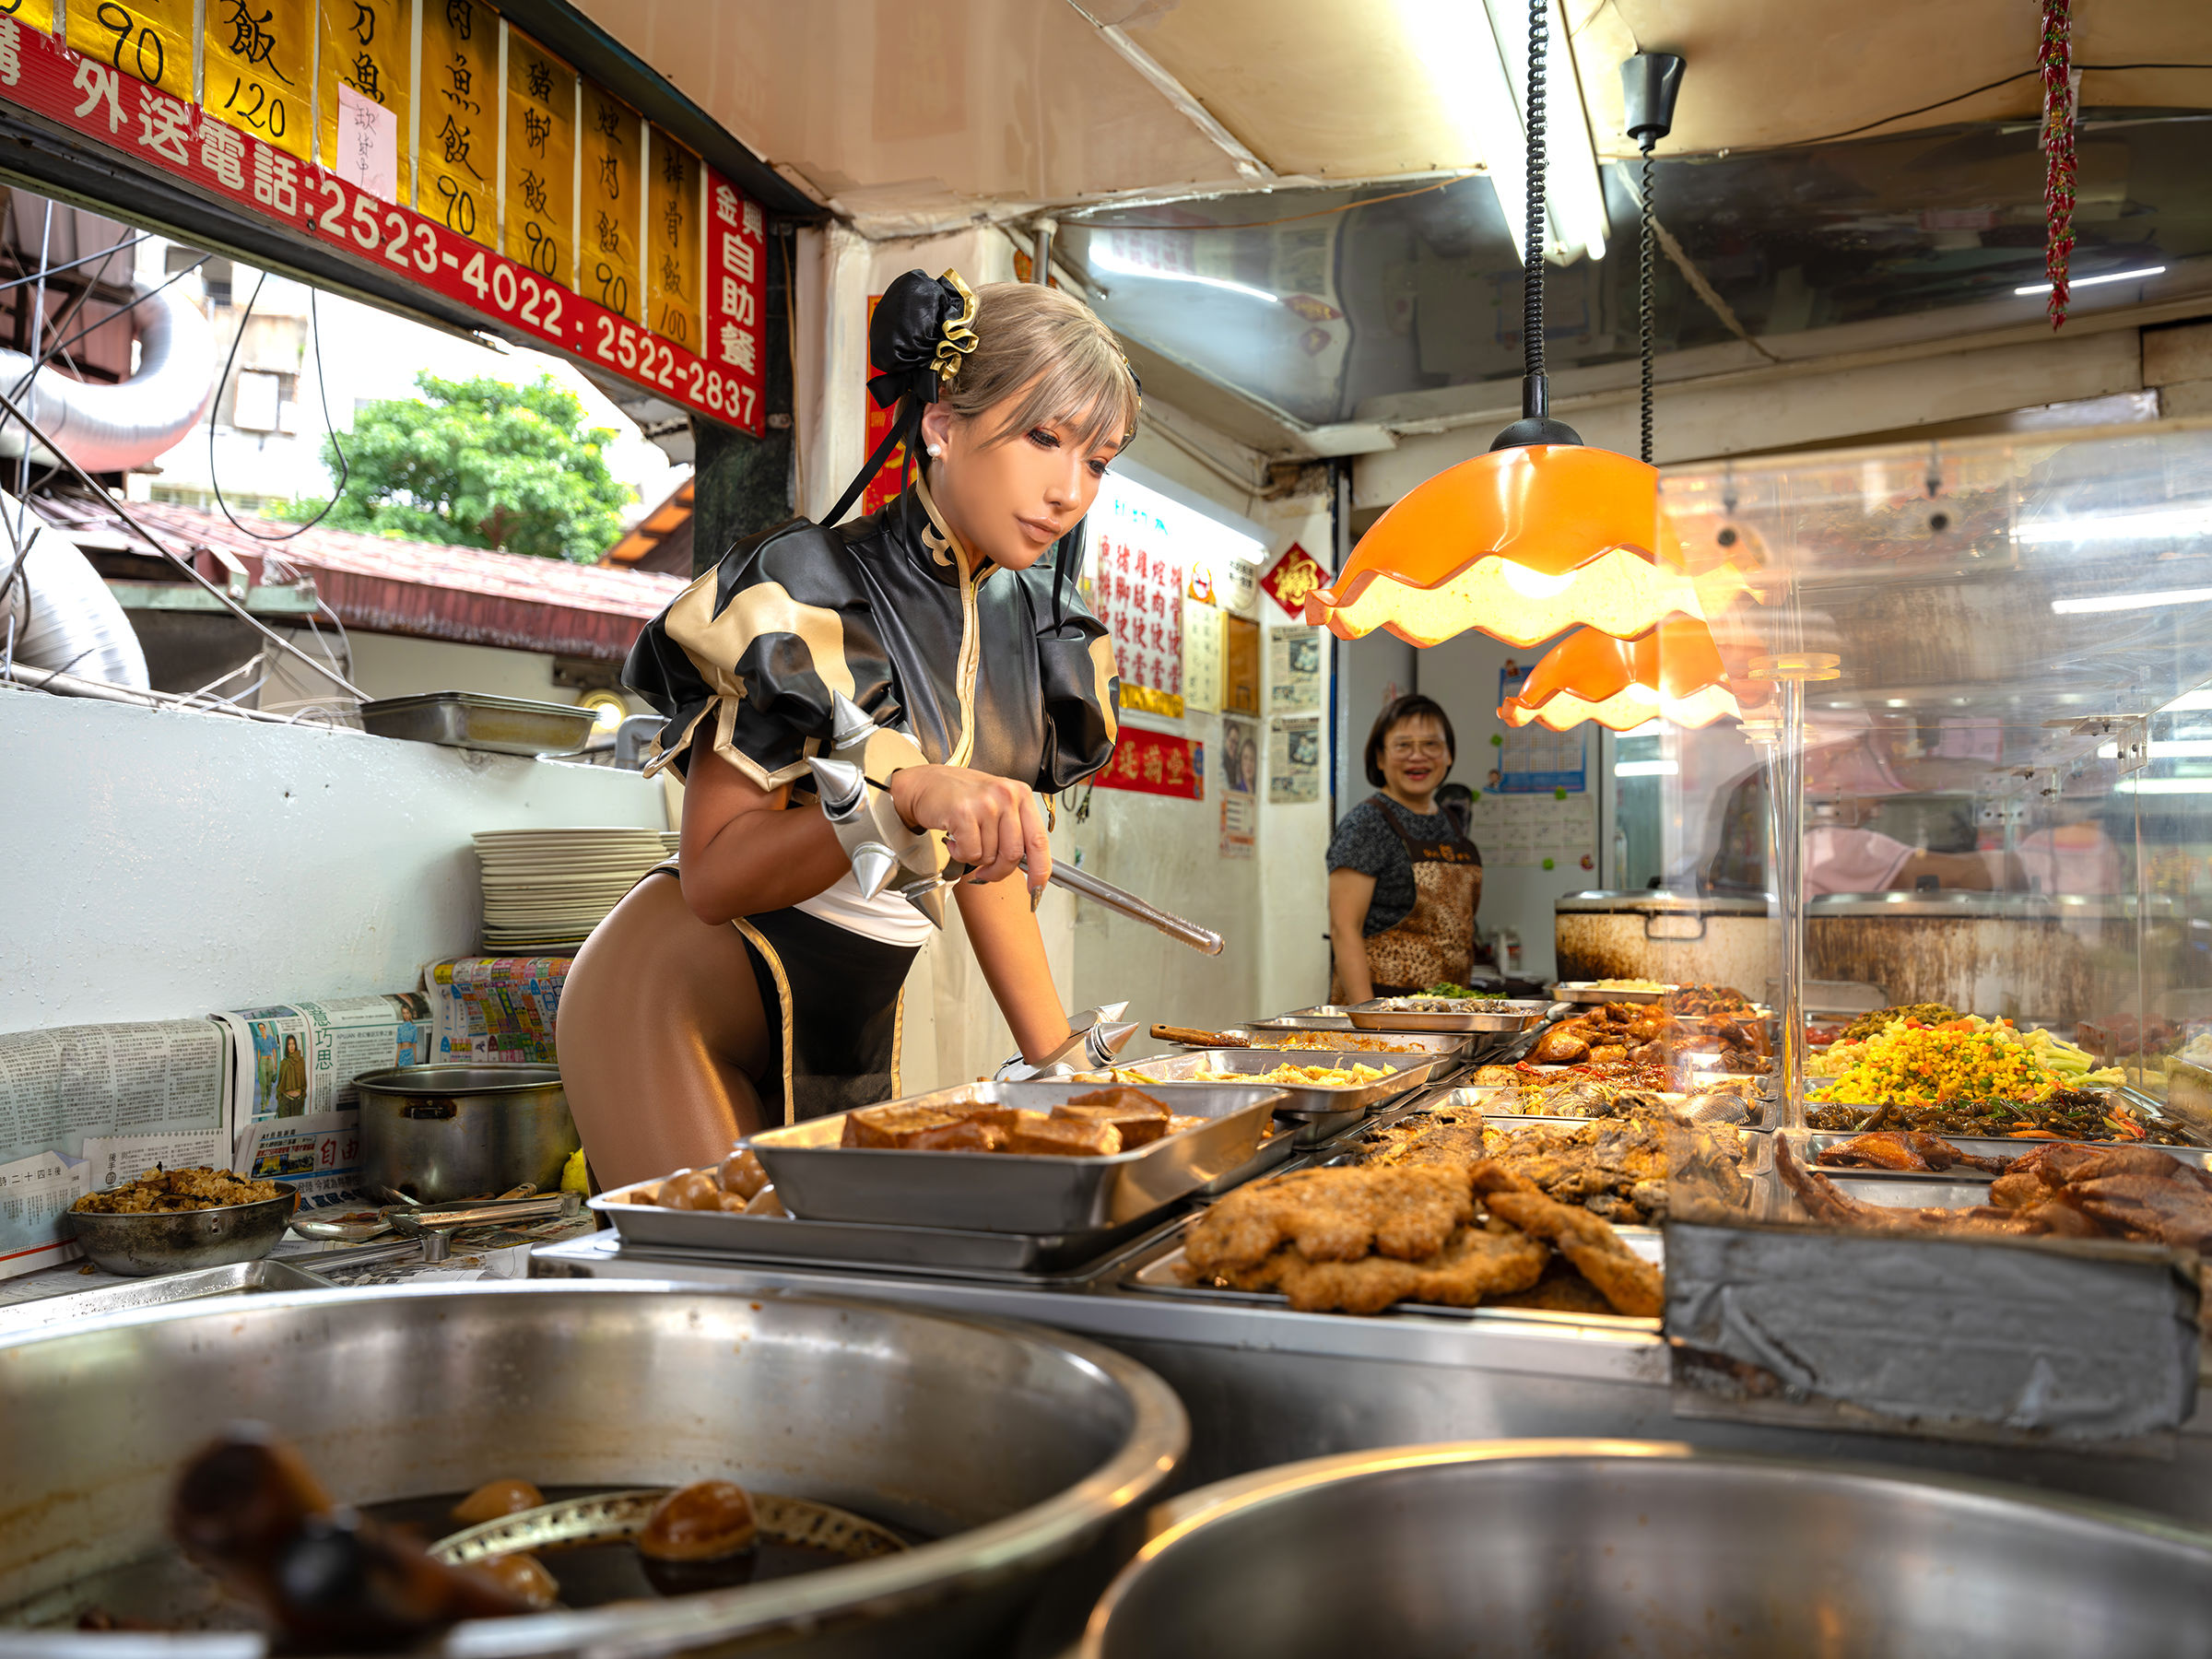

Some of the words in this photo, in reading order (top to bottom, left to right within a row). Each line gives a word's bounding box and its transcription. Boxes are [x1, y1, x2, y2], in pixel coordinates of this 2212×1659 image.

[97, 4, 163, 85] 90
[219, 0, 295, 86] 飯
[344, 1, 385, 103] 刀魚
[224, 76, 286, 137] 120
[438, 174, 476, 236] 90
[663, 147, 688, 302] 排骨飯
[524, 221, 557, 277] 90
[595, 263, 628, 317] 90
[659, 303, 687, 342] 100
[721, 231, 755, 375] 自助餐
[596, 315, 756, 425] 2522-2837
[320, 1137, 359, 1166] 自由
